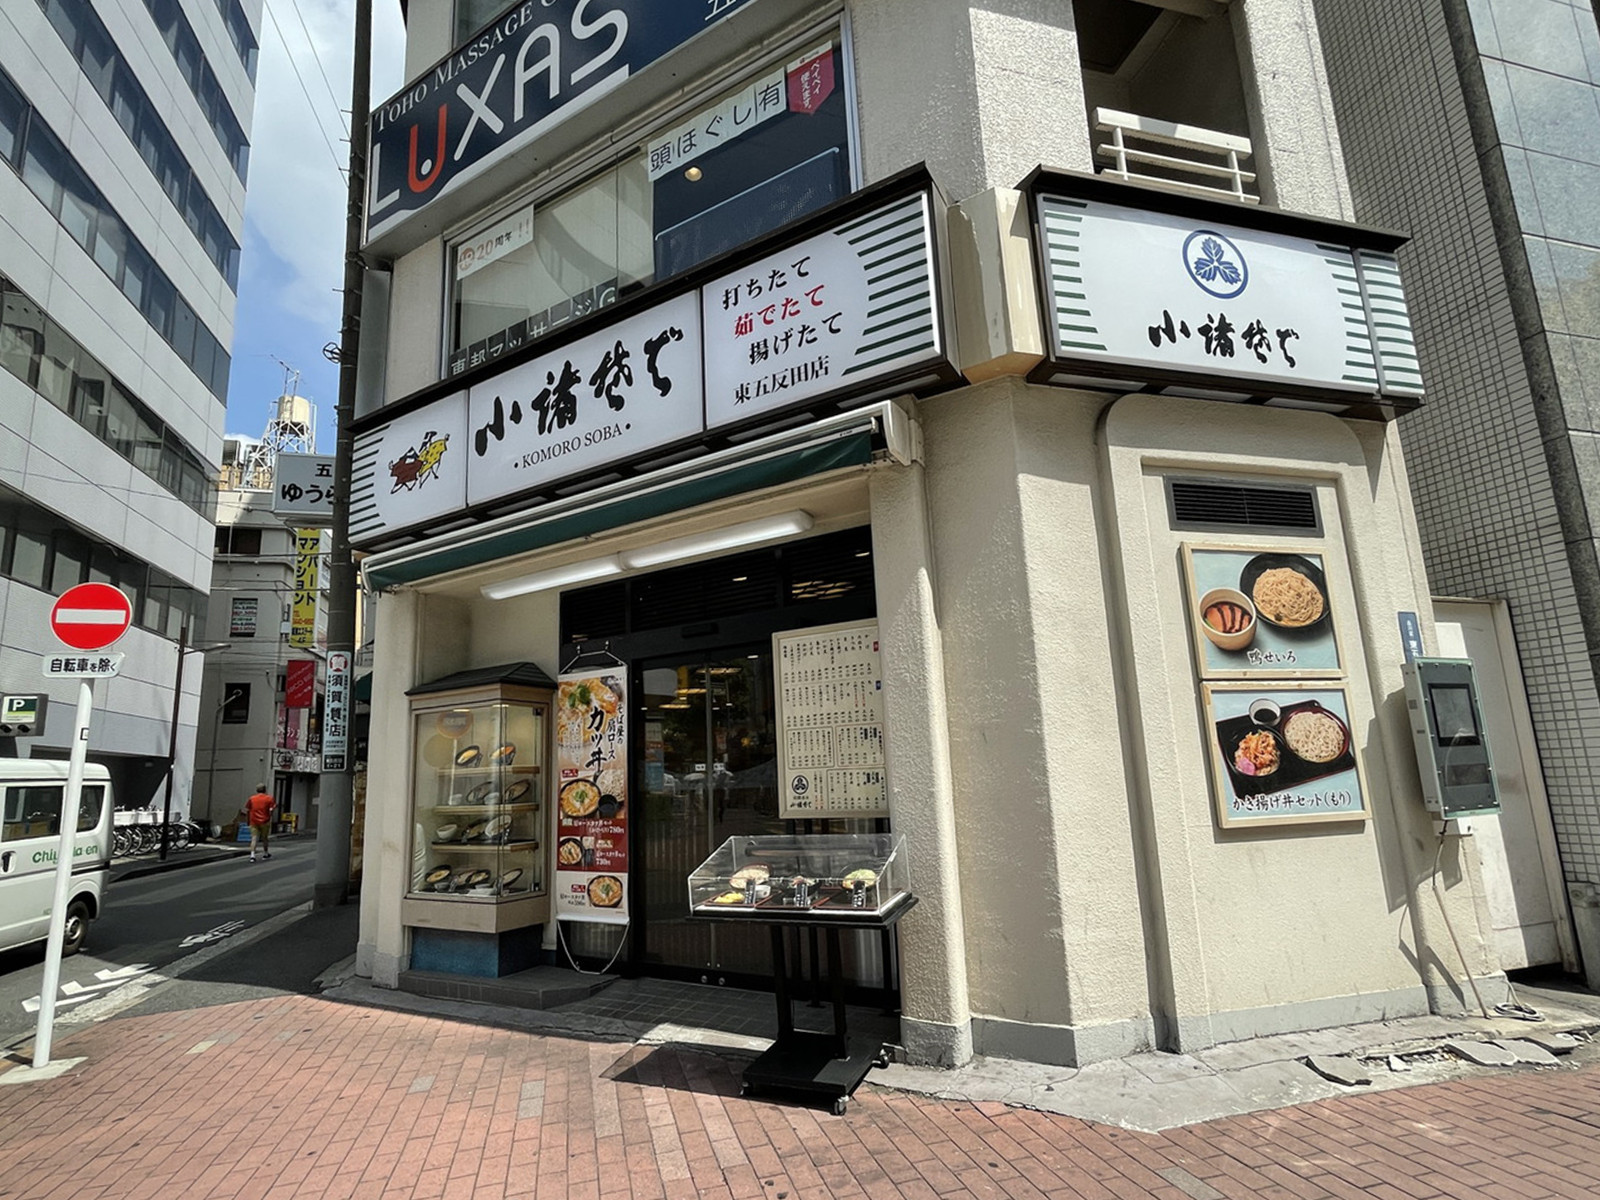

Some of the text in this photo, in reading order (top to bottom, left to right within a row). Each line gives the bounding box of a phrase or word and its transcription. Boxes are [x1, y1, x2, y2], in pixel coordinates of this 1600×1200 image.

[376, 2, 533, 133] TOHO MASSAGE
[370, 0, 629, 216] LUXAS
[650, 80, 783, 172] 頭ほぐし 有
[722, 256, 811, 310] 打ちたて
[734, 285, 825, 339] 茹でたて
[749, 312, 843, 366] 揚げたて
[733, 355, 830, 406] 東五反田店
[521, 423, 622, 469] KOMORO SOBA
[293, 537, 308, 605] マンション
[307, 537, 320, 605] アパート
[50, 658, 116, 673] 自転車を除く
[12, 699, 25, 711] P
[585, 706, 608, 783] カツ丼
